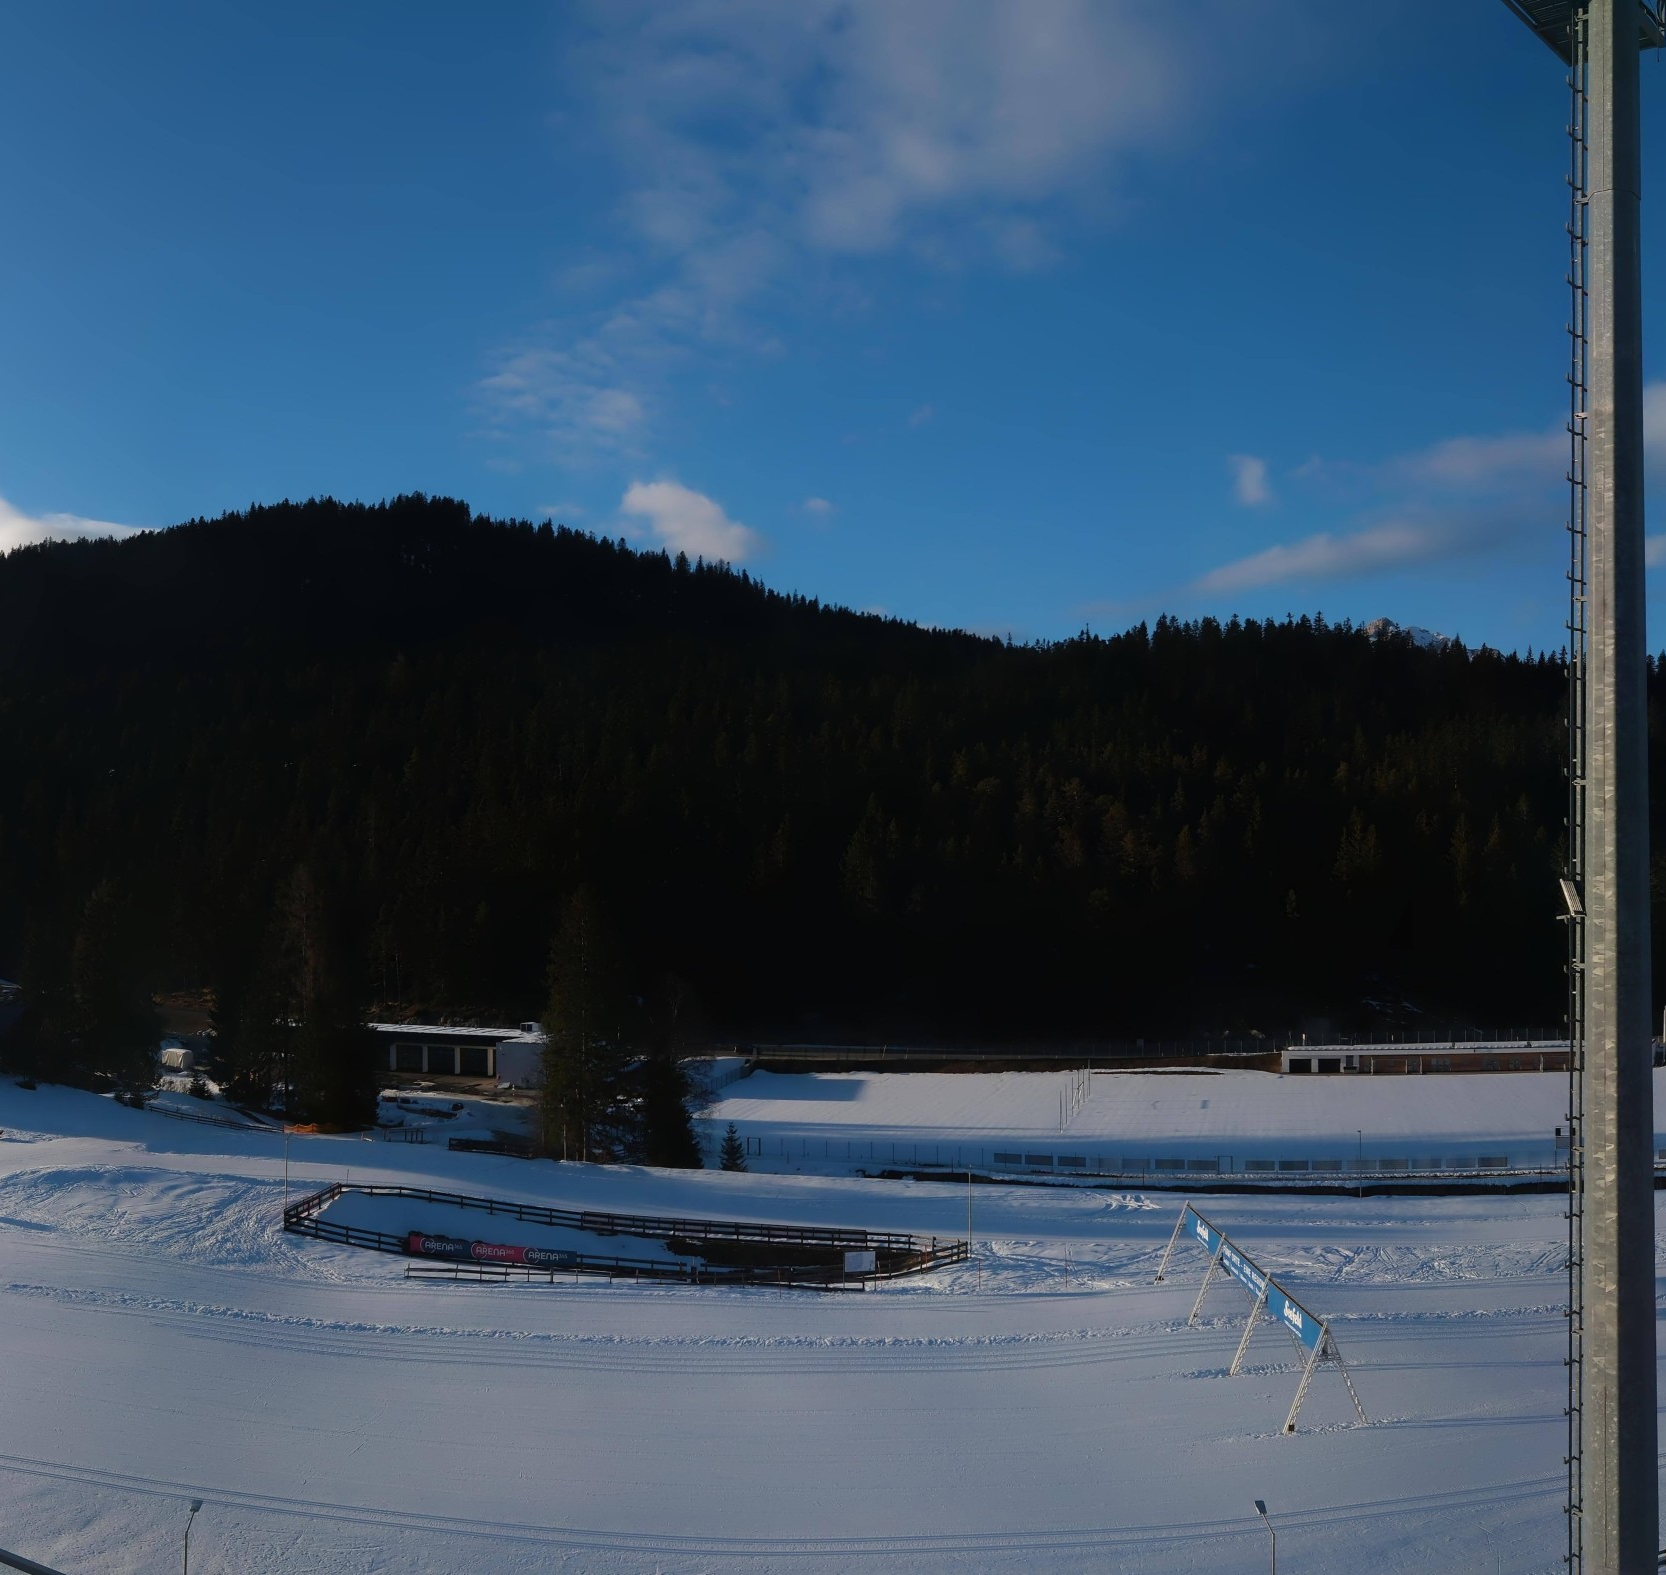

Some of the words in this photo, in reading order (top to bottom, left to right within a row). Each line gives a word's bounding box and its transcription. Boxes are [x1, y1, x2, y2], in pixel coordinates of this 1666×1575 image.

[425, 1241, 454, 1251] ARENA
[475, 1246, 506, 1256] ARENA
[528, 1250, 559, 1261] ARENA
[1284, 1300, 1302, 1329] Seefeld
